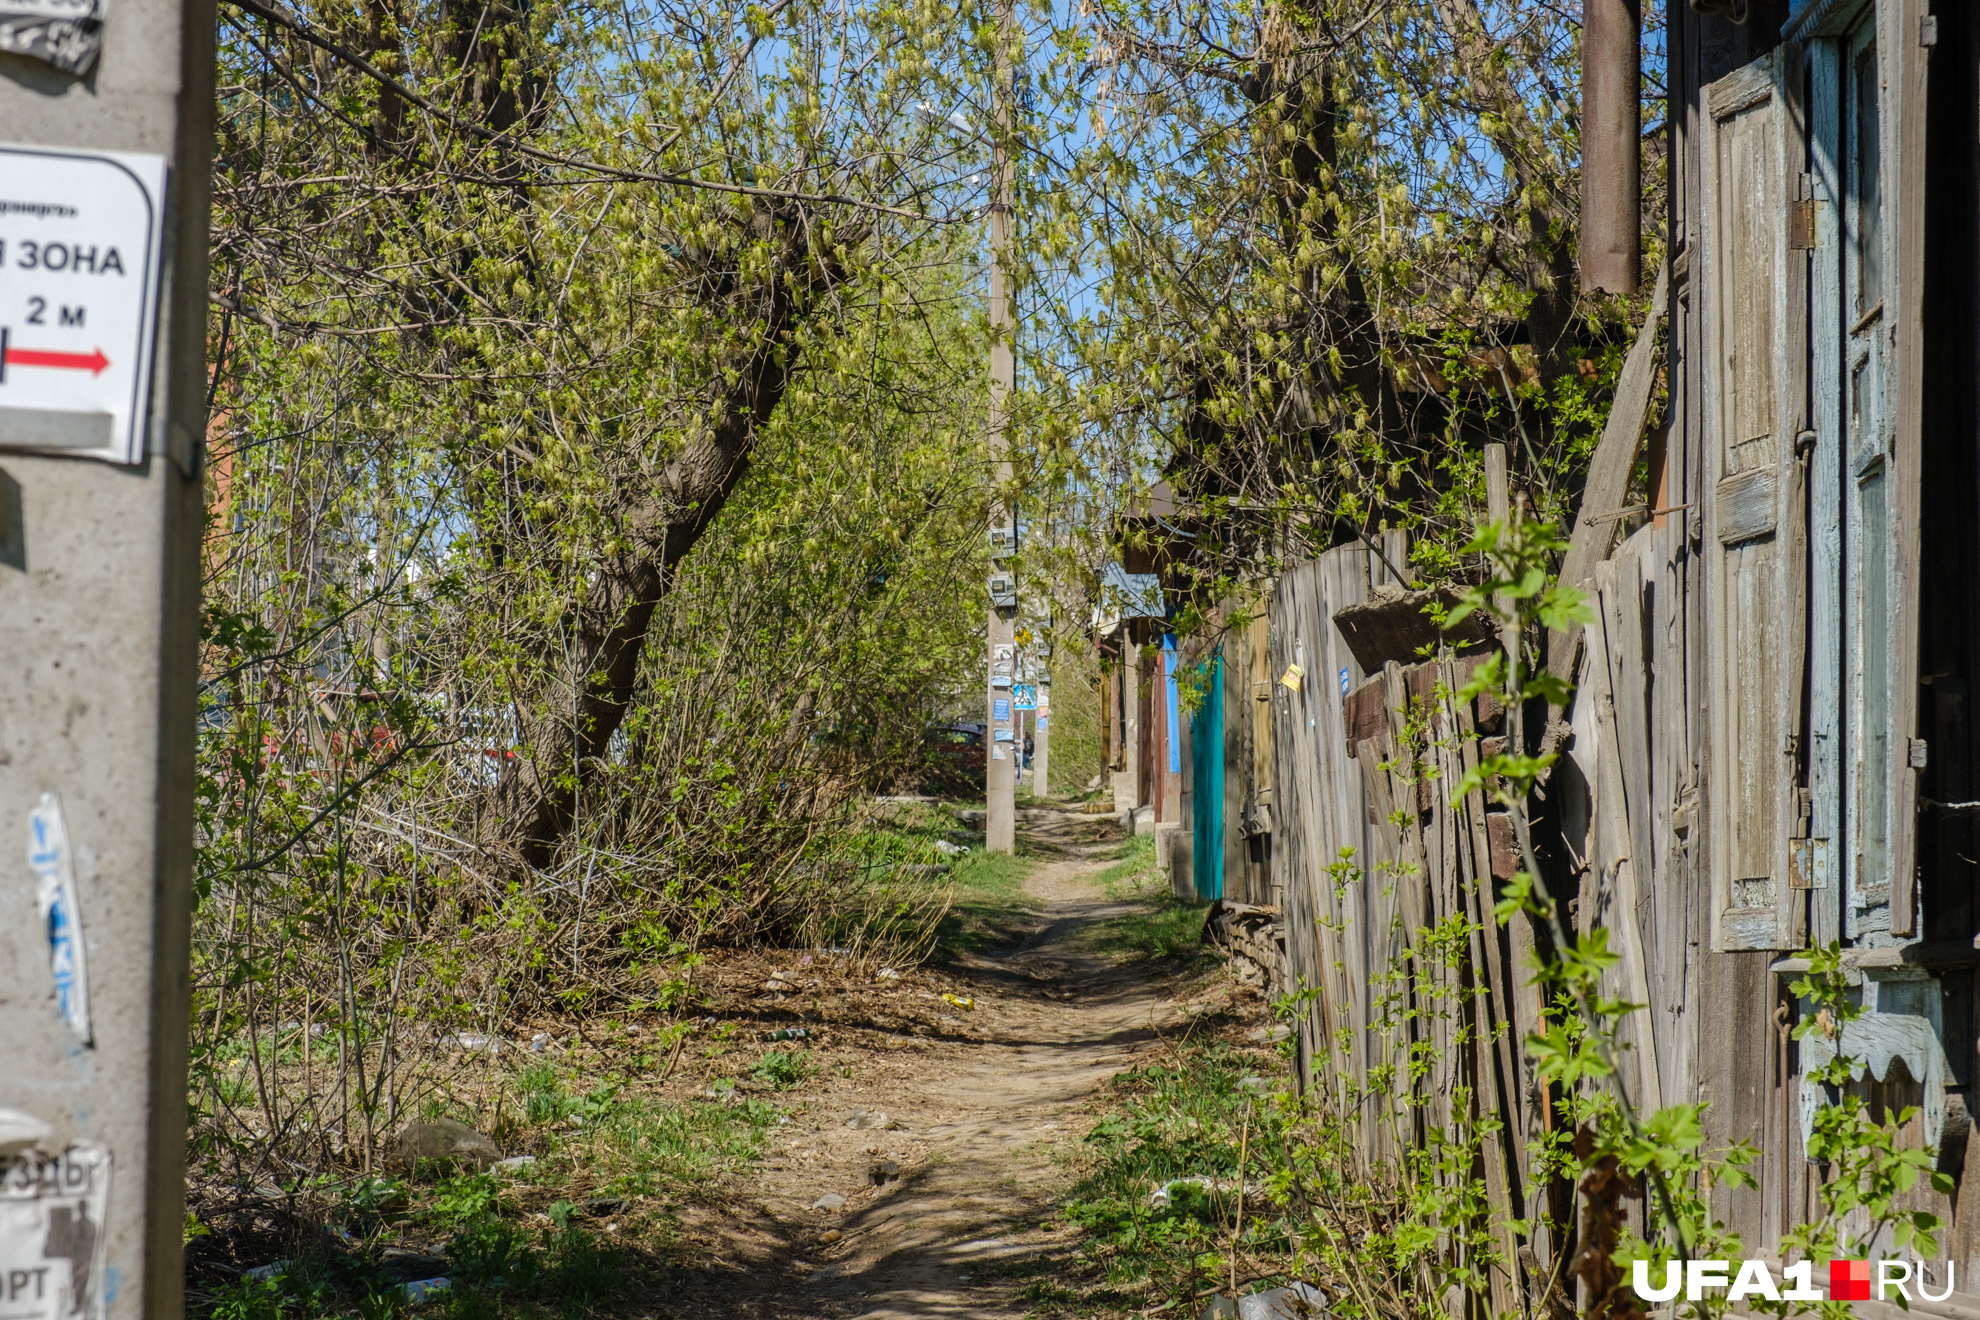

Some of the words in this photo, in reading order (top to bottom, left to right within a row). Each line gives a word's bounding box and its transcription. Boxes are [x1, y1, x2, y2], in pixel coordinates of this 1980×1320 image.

[17, 239, 125, 276] ЗОНА
[26, 295, 47, 326] 2
[0, 1267, 49, 1301] РТ
